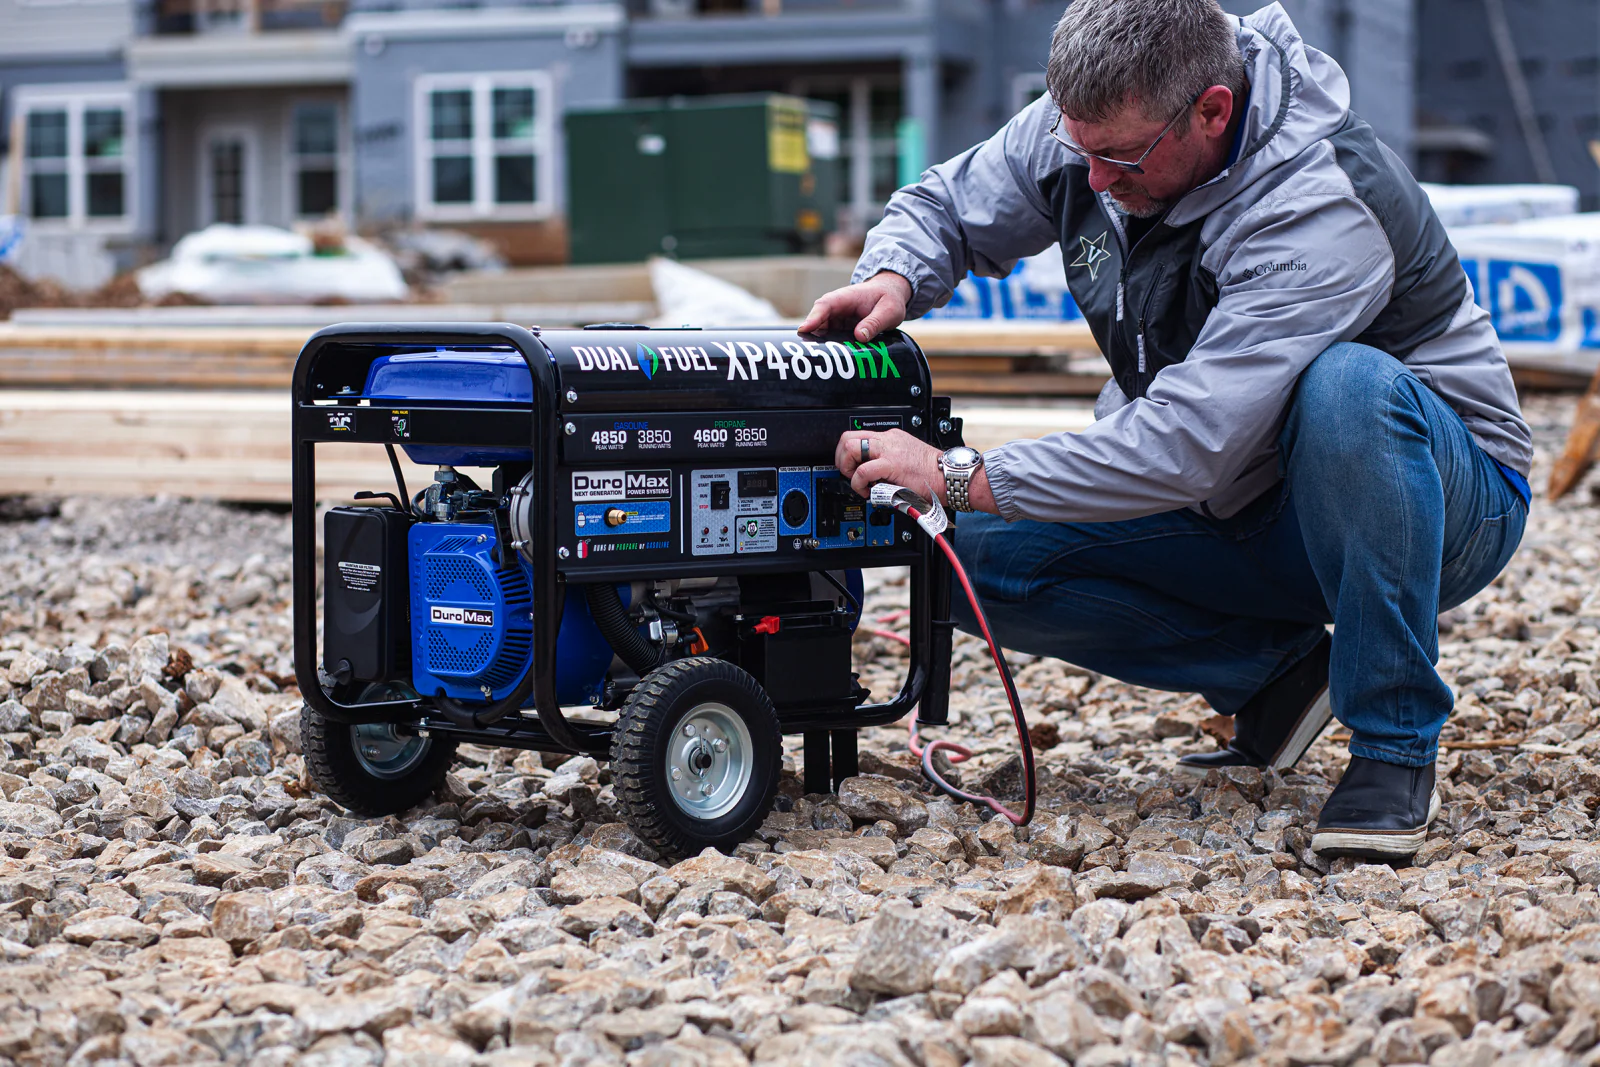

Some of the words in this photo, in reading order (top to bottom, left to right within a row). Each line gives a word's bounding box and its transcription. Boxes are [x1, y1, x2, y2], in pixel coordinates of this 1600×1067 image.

[1087, 245, 1102, 264] V
[1254, 260, 1307, 276] Columbia
[571, 346, 639, 371] DUAL
[657, 346, 718, 371] FUEL
[710, 341, 901, 381] XP4850HX
[613, 421, 649, 431] GASOLINE
[714, 420, 746, 428] PROPANE
[591, 430, 628, 445] 4850
[637, 429, 672, 444] 3850
[693, 429, 728, 443] 4600
[734, 428, 768, 442] 3650
[593, 544, 607, 552] RUNS
[607, 543, 615, 551] ON
[615, 542, 638, 551] PROPANE
[646, 541, 670, 549] GASOLINE
